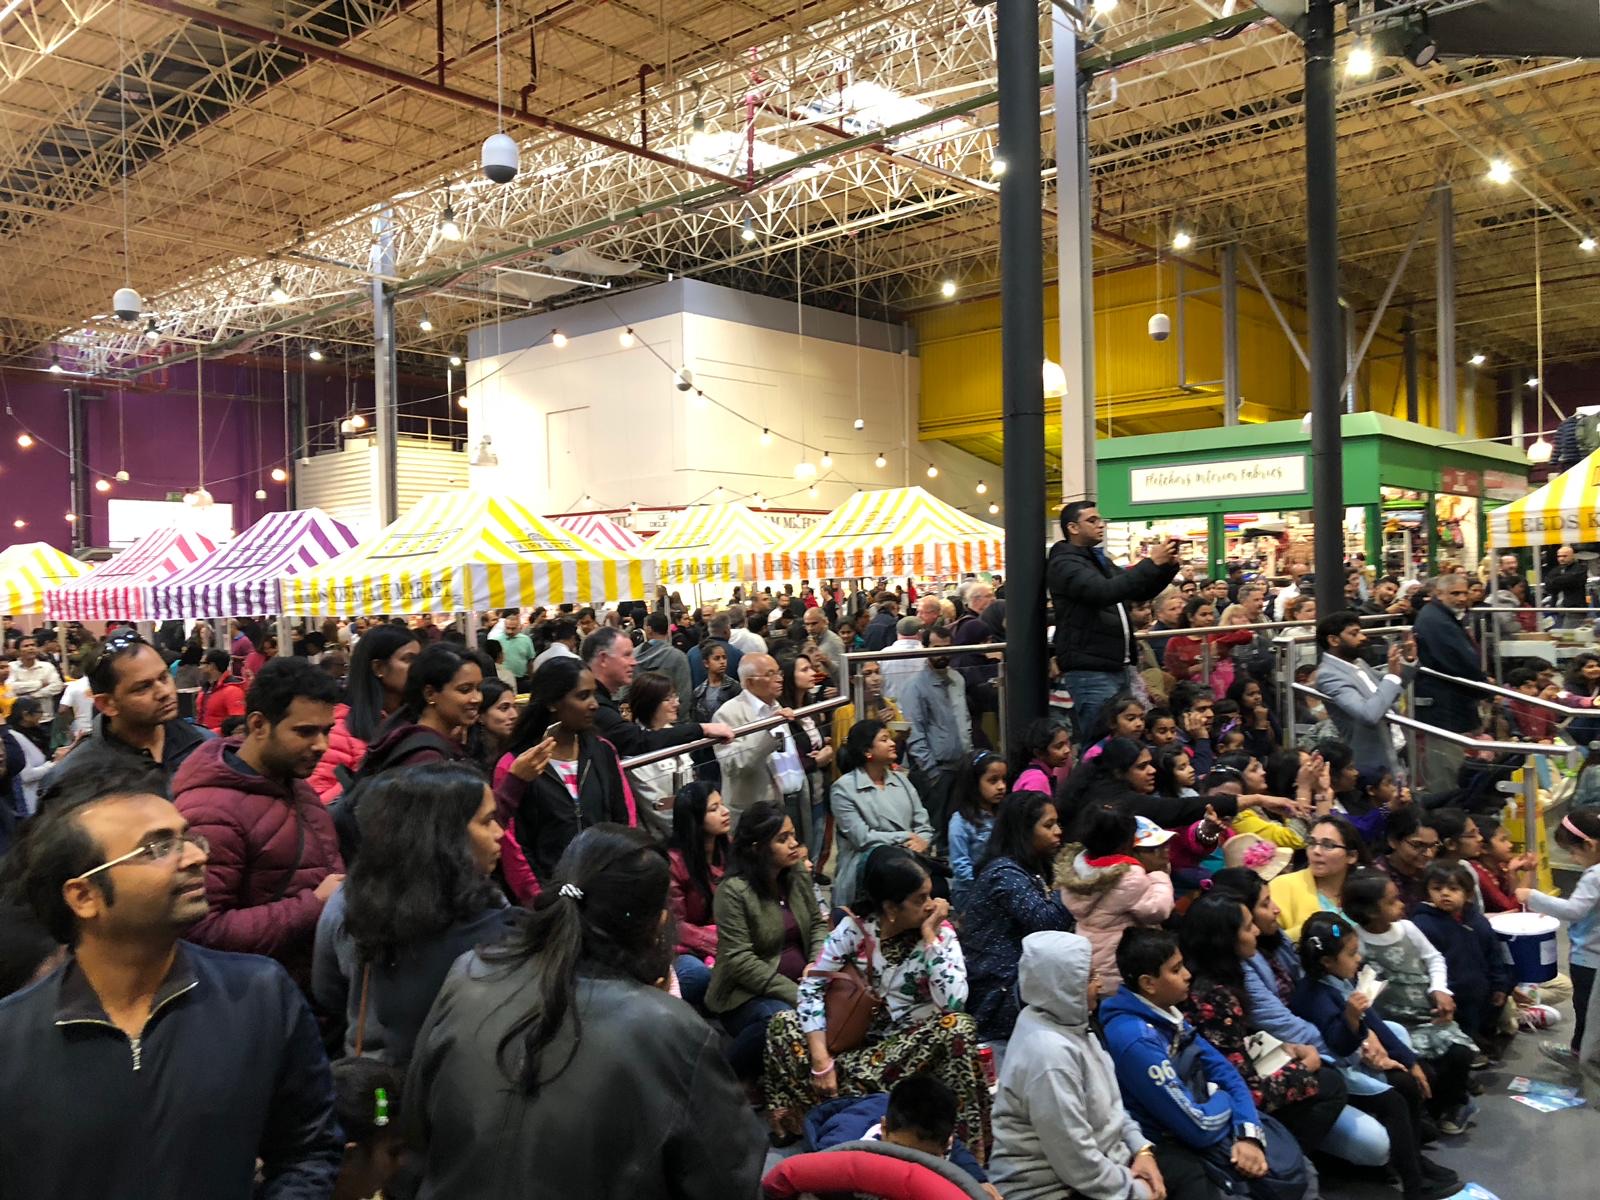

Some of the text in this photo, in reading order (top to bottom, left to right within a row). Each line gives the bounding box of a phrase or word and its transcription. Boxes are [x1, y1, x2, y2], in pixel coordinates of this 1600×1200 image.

[1507, 514, 1579, 534] LEEDS
[868, 552, 924, 568] MARKET
[1147, 1059, 1178, 1086] 96
